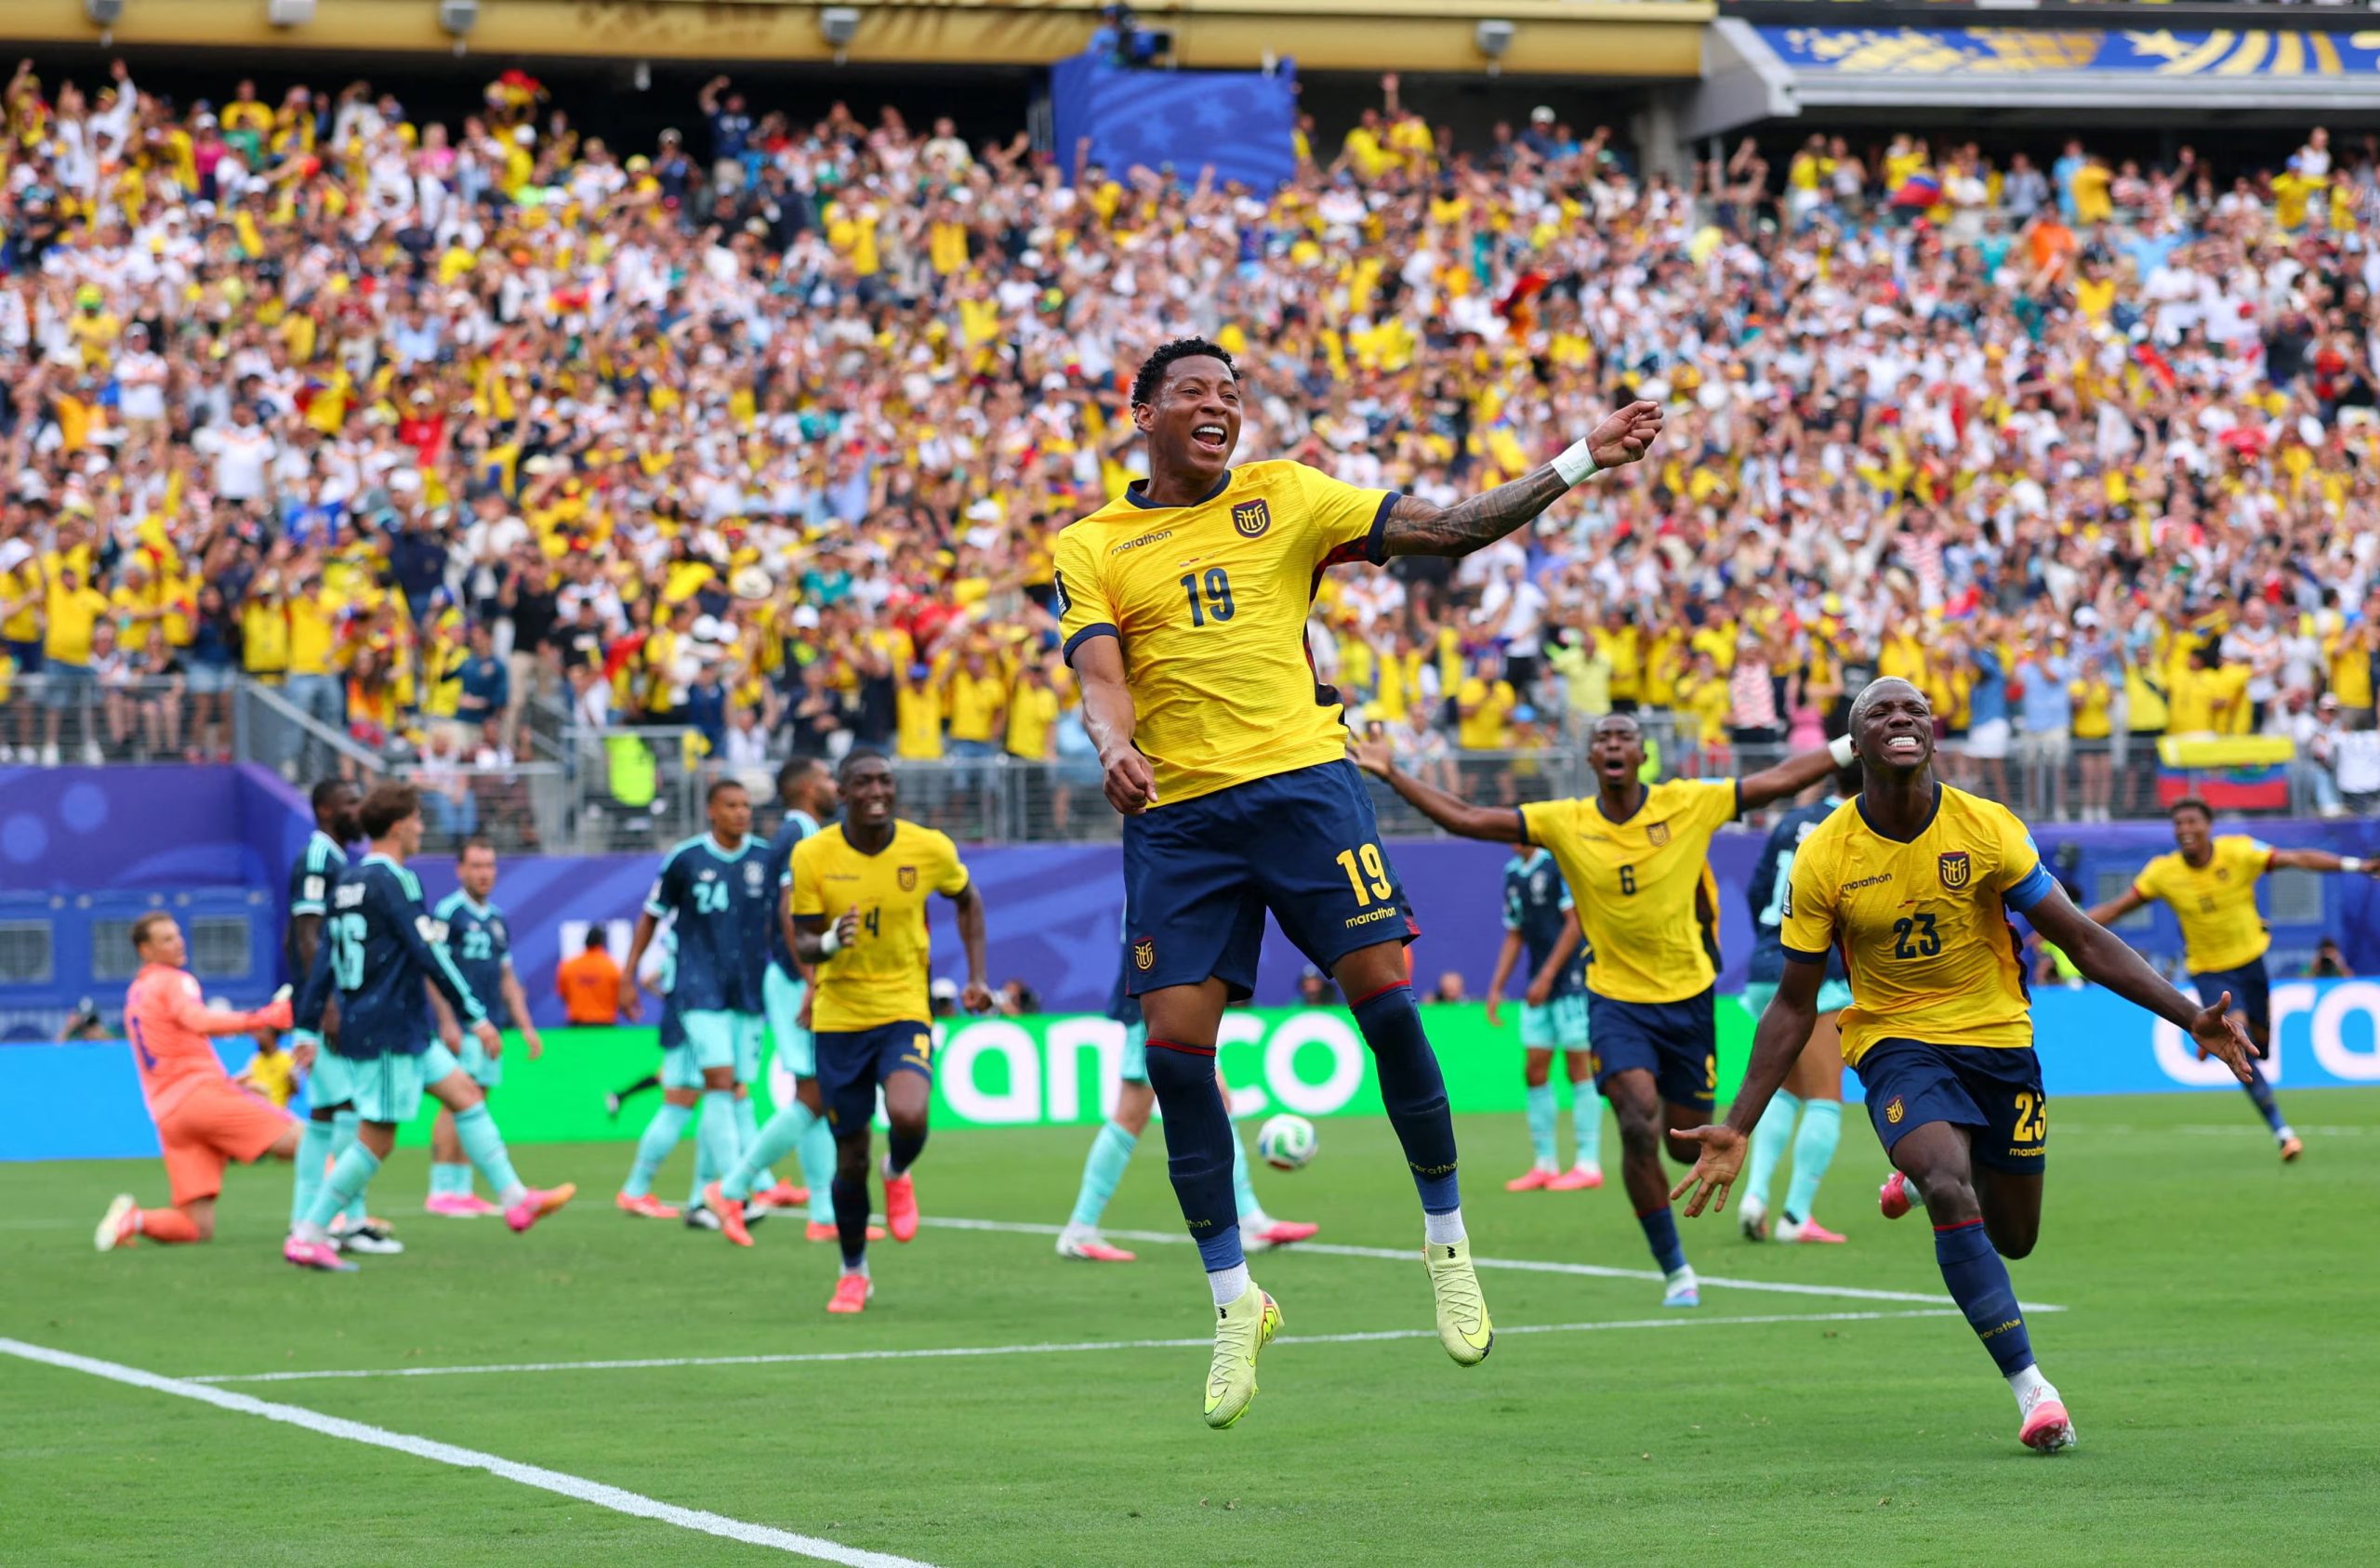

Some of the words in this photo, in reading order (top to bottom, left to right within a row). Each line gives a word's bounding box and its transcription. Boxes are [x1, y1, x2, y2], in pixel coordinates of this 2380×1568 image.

[1111, 529, 1173, 556] marathon
[1179, 567, 1236, 627] 19
[1336, 843, 1392, 907] 19
[1619, 863, 1637, 897] 6
[1841, 872, 1893, 892] marathon
[692, 880, 730, 915] 24
[865, 905, 880, 938] 4
[1345, 906, 1396, 929] marathon
[1893, 913, 1941, 959] 23
[2013, 1091, 2047, 1141] 23
